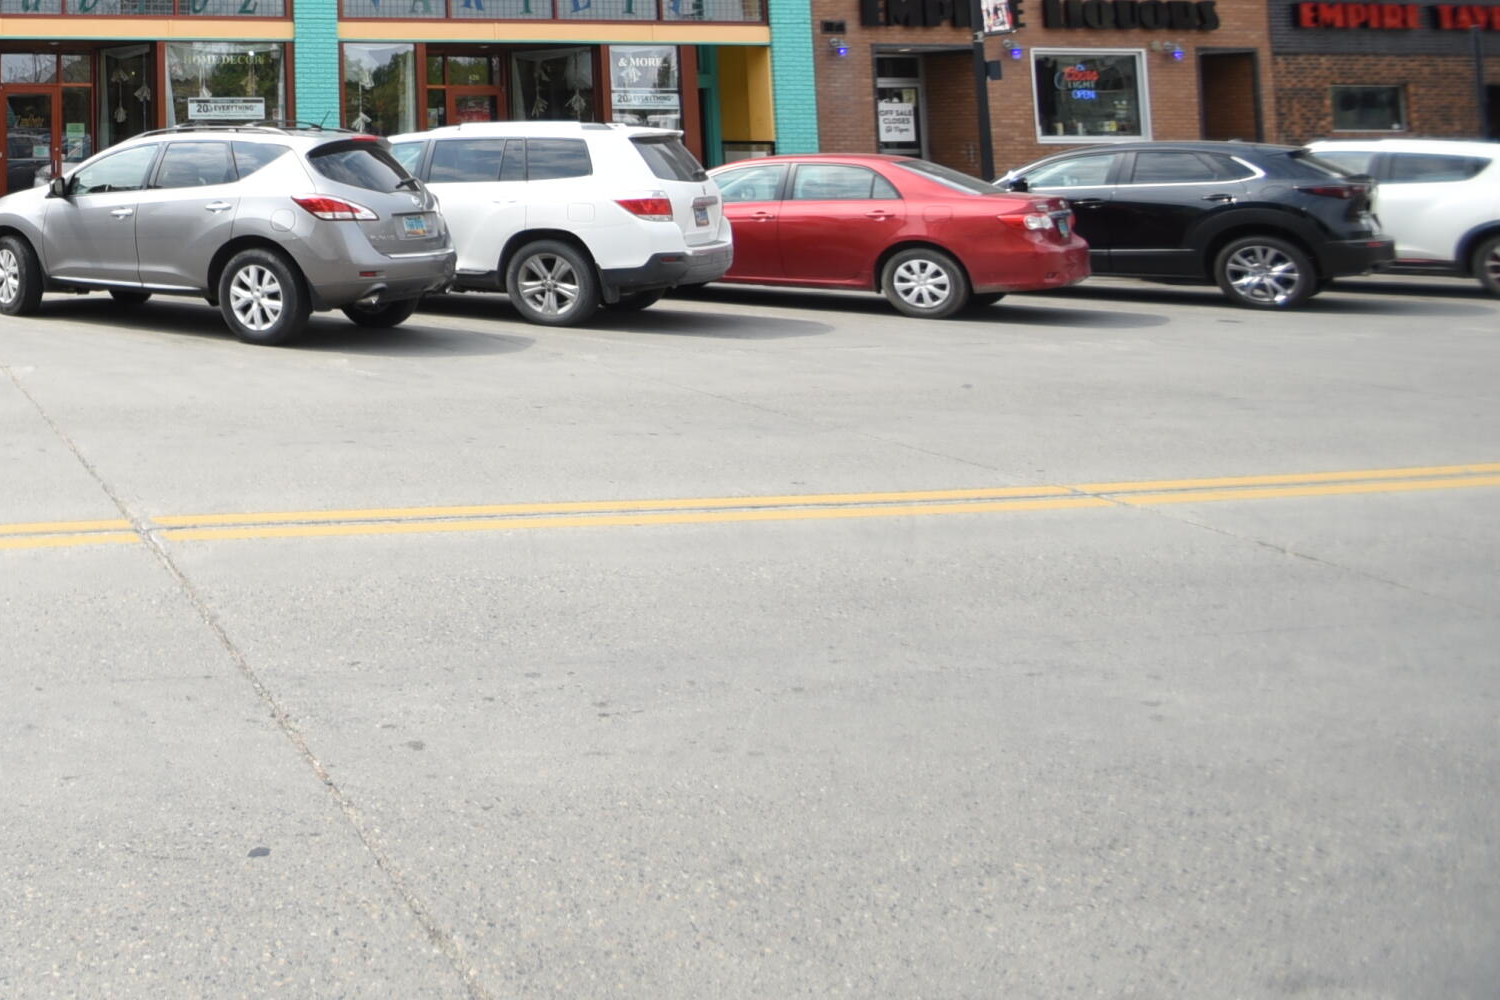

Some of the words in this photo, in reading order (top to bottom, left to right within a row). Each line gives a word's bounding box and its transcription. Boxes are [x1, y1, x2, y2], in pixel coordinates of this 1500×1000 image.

[1042, 0, 1220, 31] LIQUORS
[1298, 1, 1422, 30] EMPIRE
[618, 57, 627, 67] &
[1072, 89, 1098, 100] OPEN
[197, 104, 209, 113] 20
